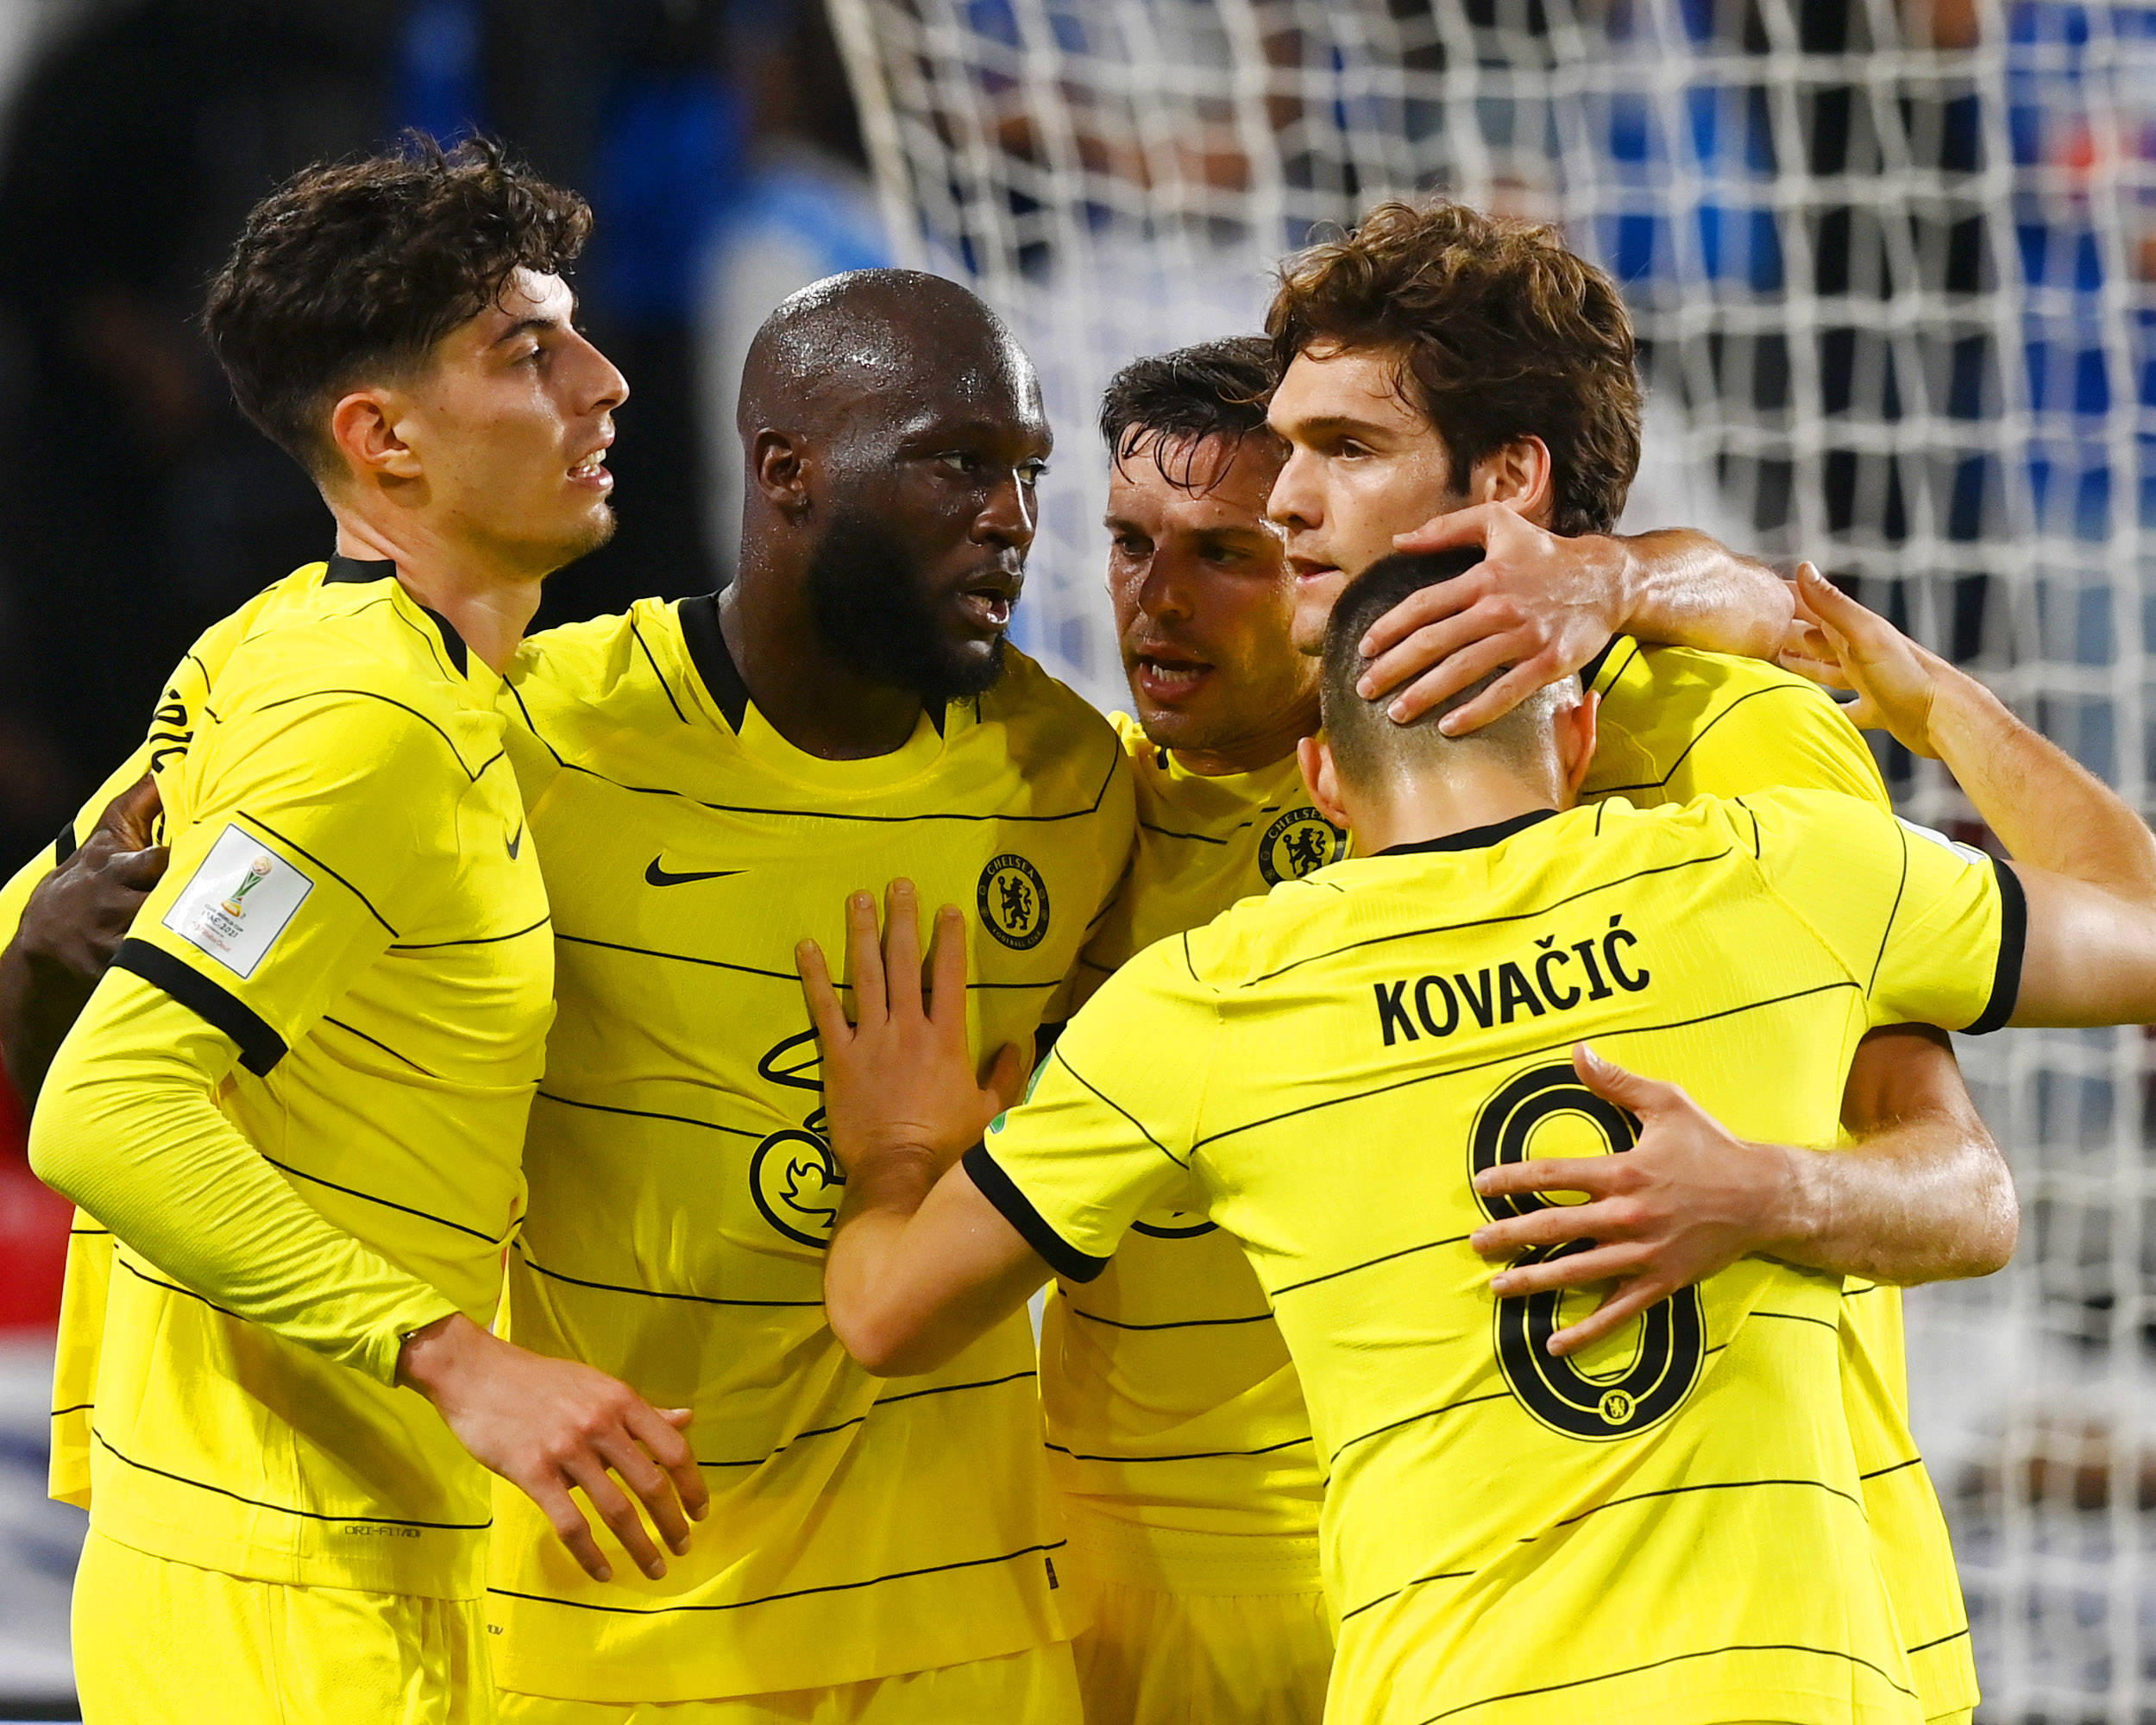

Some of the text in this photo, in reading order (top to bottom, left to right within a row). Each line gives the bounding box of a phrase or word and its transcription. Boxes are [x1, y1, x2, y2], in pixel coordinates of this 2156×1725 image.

[986, 855, 1035, 878] CHELSEA
[1373, 914, 1650, 1047] KOVAČIĆ
[1466, 1057, 1707, 1443] 8
